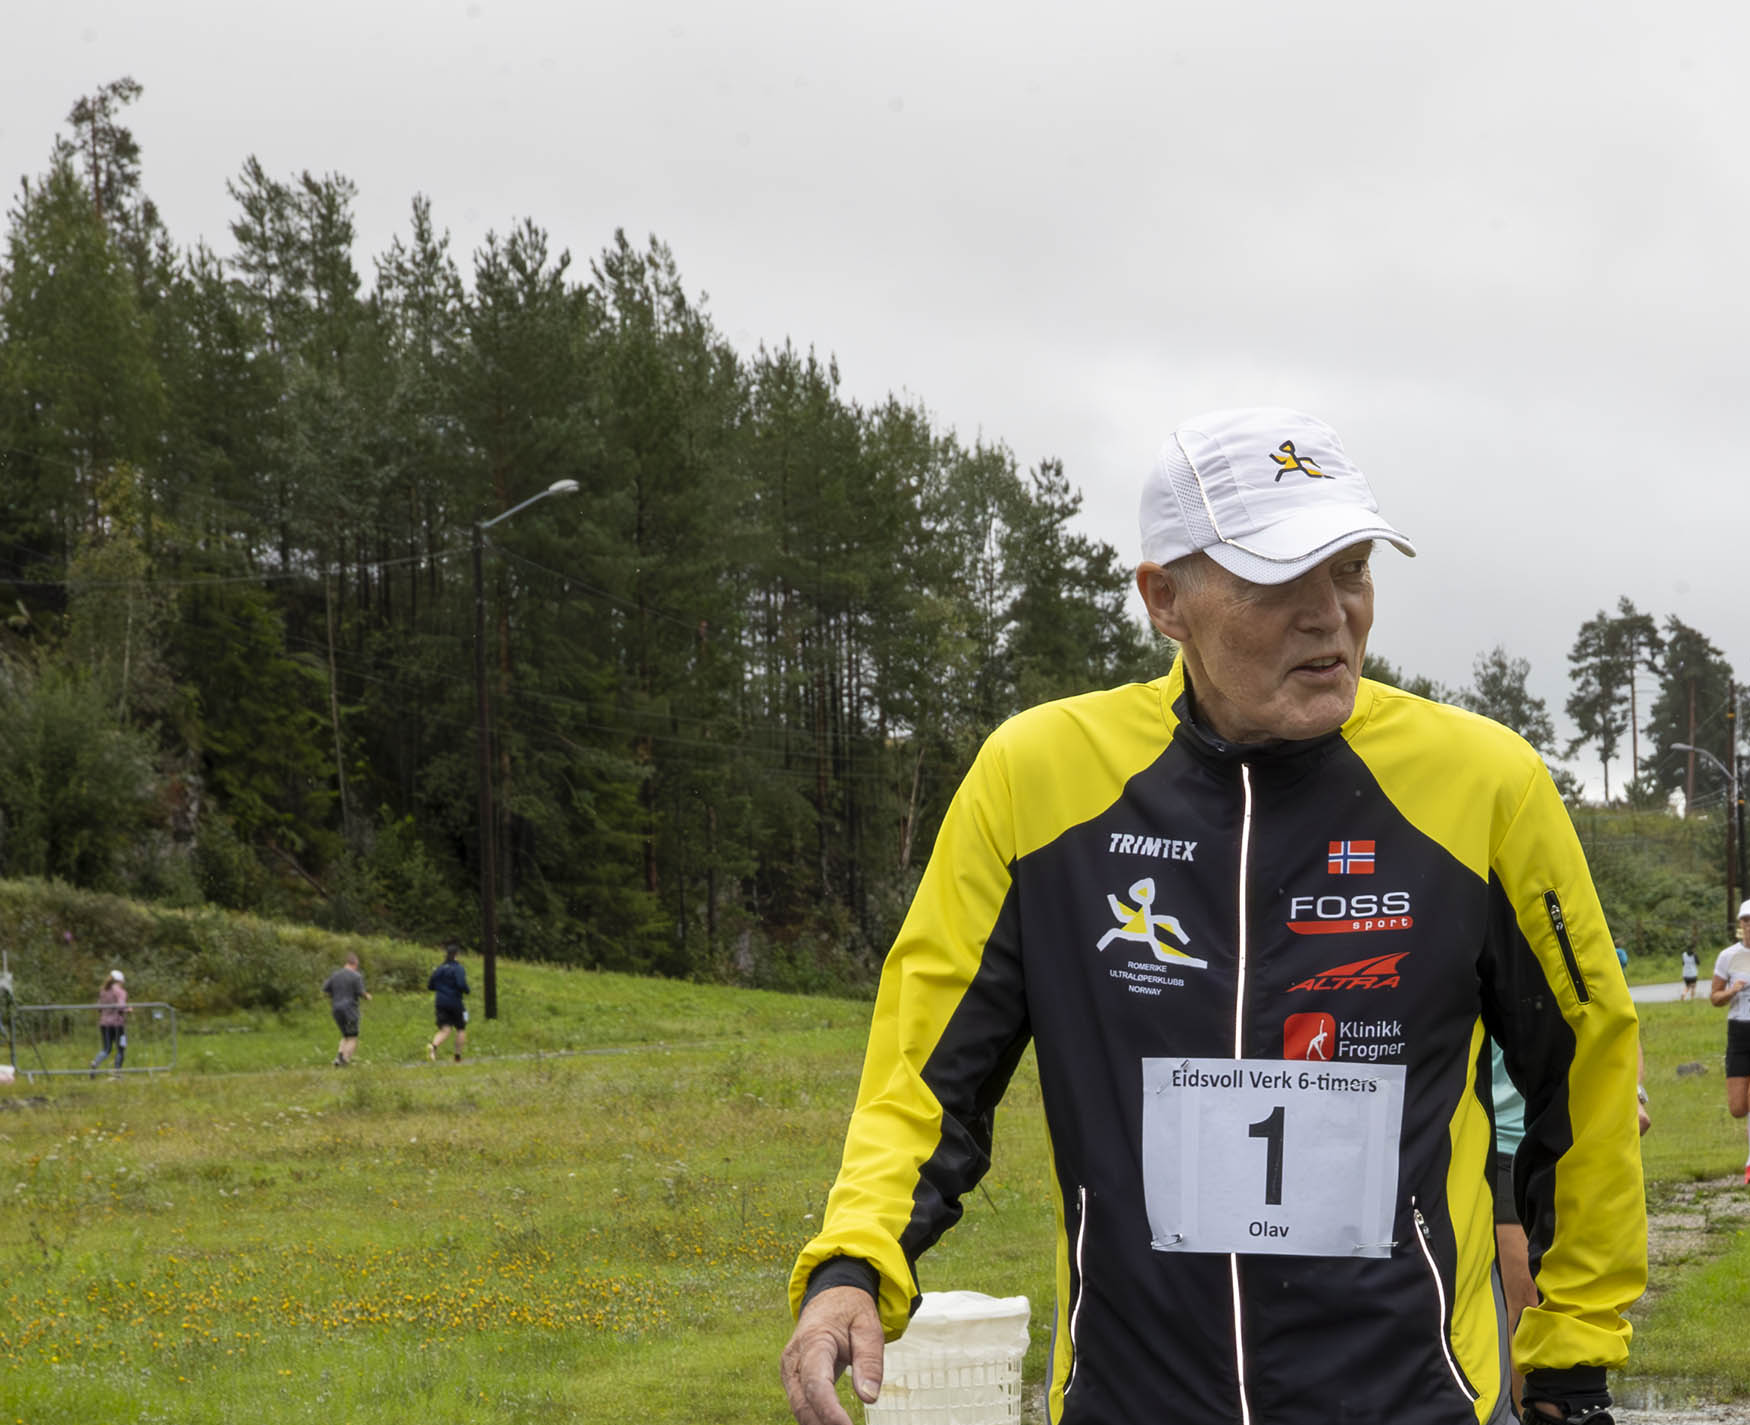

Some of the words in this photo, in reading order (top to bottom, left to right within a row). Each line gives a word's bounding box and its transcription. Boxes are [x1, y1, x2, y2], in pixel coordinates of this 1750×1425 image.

[1109, 833, 1198, 862] TRIMTEX
[1290, 891, 1410, 920] FOSS
[1352, 917, 1408, 930] sport
[1127, 961, 1168, 973] ROMERIKE
[1128, 985, 1162, 996] NORWAY
[1286, 975, 1401, 993] ALTRA
[1339, 1020, 1402, 1039] Klinikk
[1338, 1041, 1406, 1061] Frogner
[1172, 1069, 1243, 1088] Eidsvoll
[1249, 1071, 1292, 1089] Verk
[1298, 1072, 1377, 1093] 6-timers
[1248, 1106, 1285, 1205] 1
[1248, 1222, 1290, 1239] Olav
